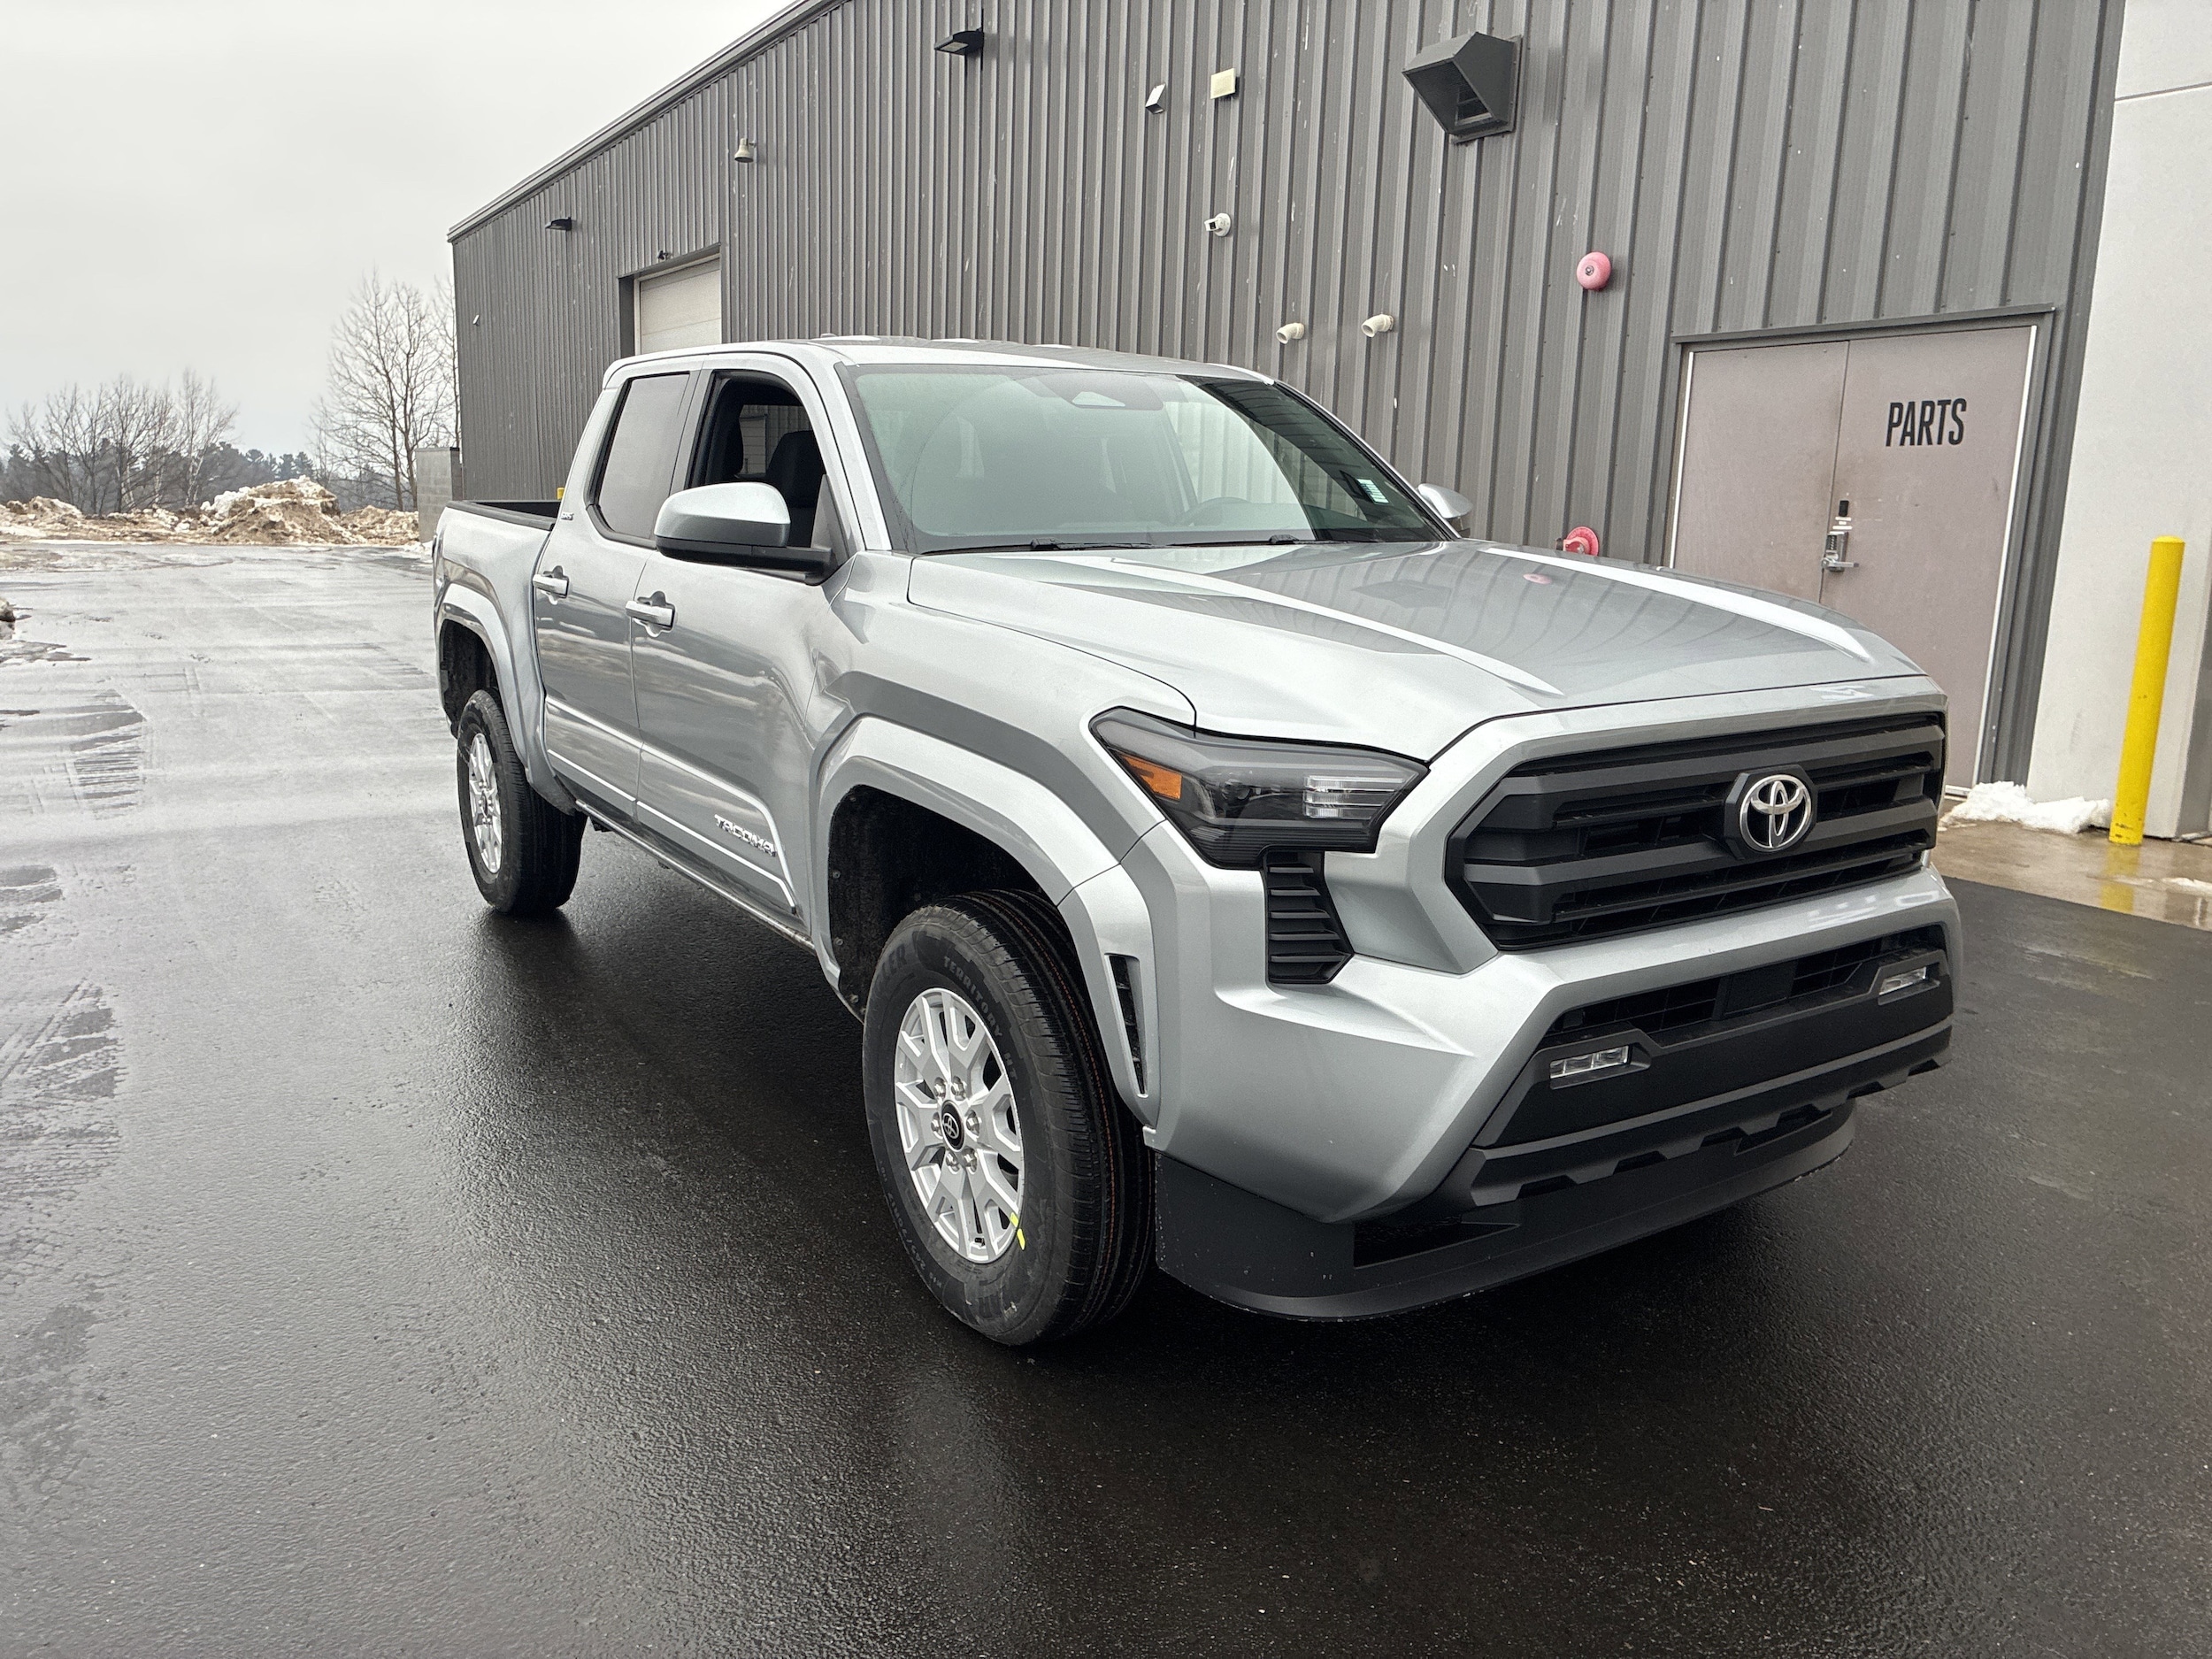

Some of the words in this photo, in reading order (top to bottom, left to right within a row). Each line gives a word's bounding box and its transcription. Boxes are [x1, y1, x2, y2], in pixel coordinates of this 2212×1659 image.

[1886, 397, 1967, 447] PARTS
[714, 814, 777, 856] TACOMA
[943, 956, 1002, 1036] TERRITORY
